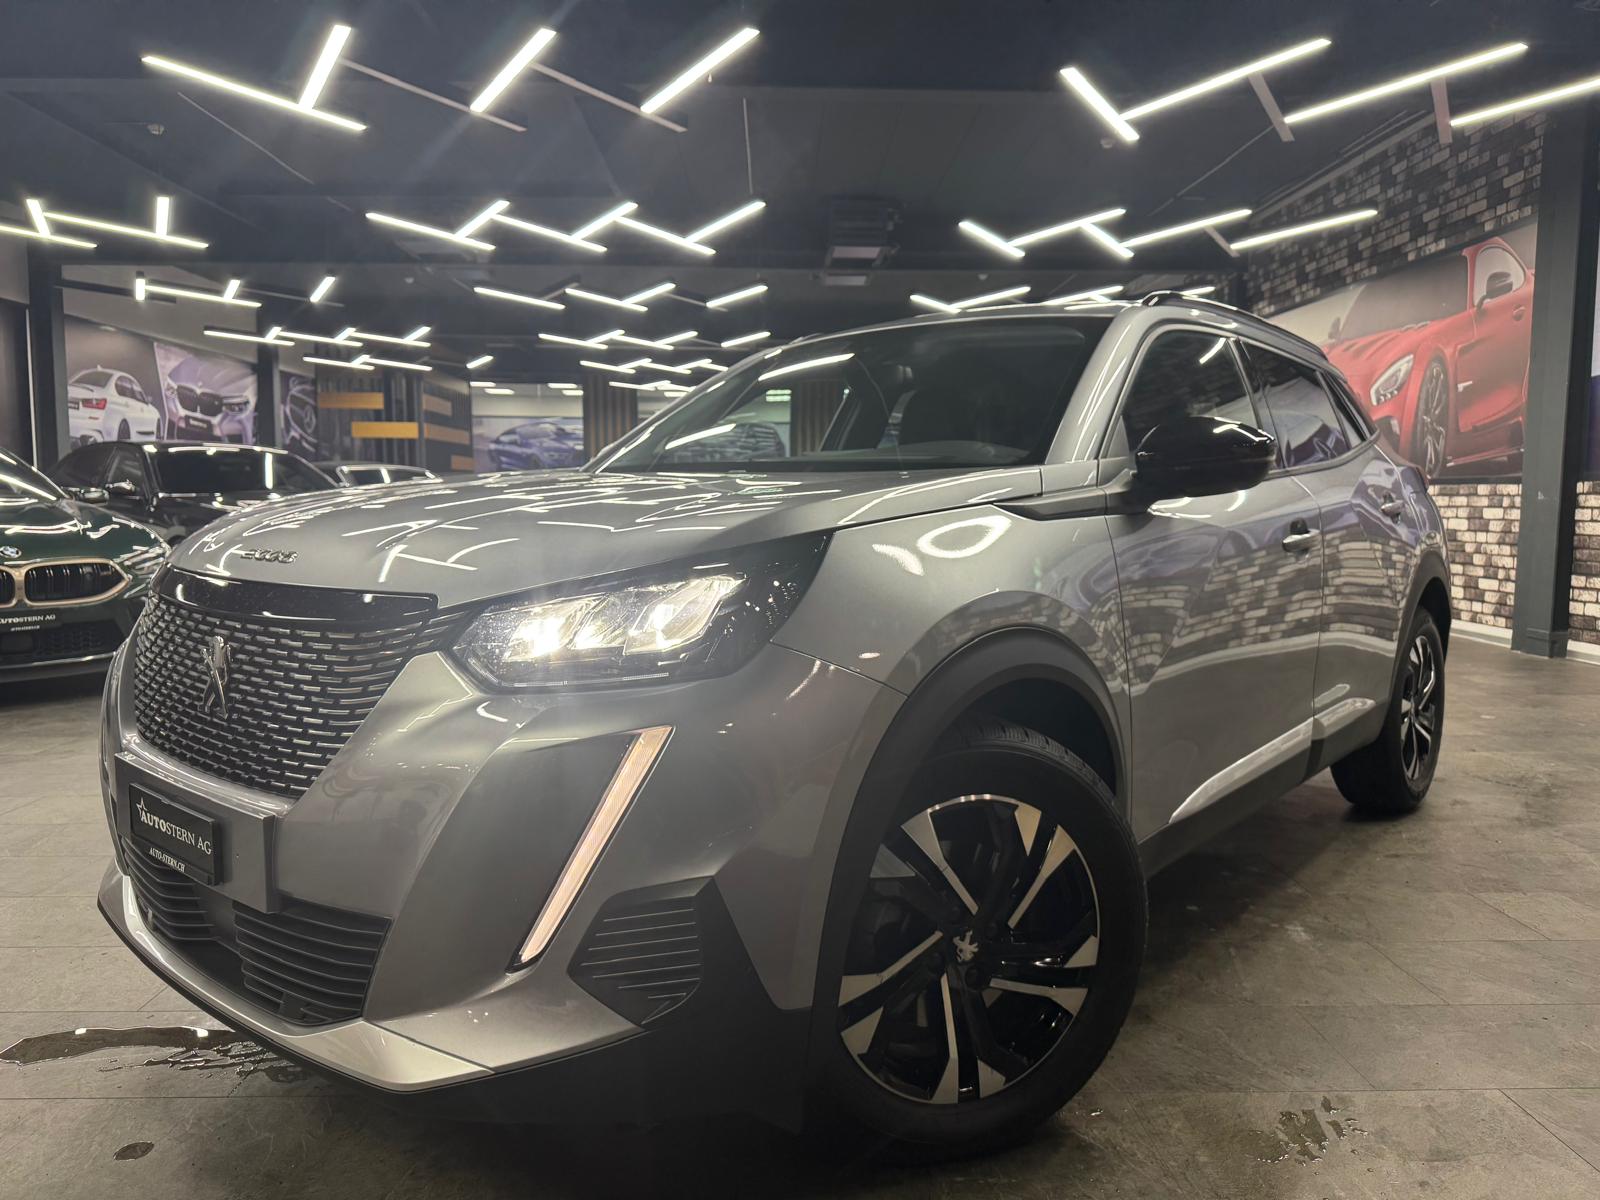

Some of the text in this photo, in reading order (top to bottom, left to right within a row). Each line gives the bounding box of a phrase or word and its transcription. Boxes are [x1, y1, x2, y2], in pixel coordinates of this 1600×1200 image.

[0, 616, 44, 624] UTOSTERN
[140, 811, 212, 855] AUTOSTERN AG
[149, 847, 186, 873] AUTO-STERN.CH
